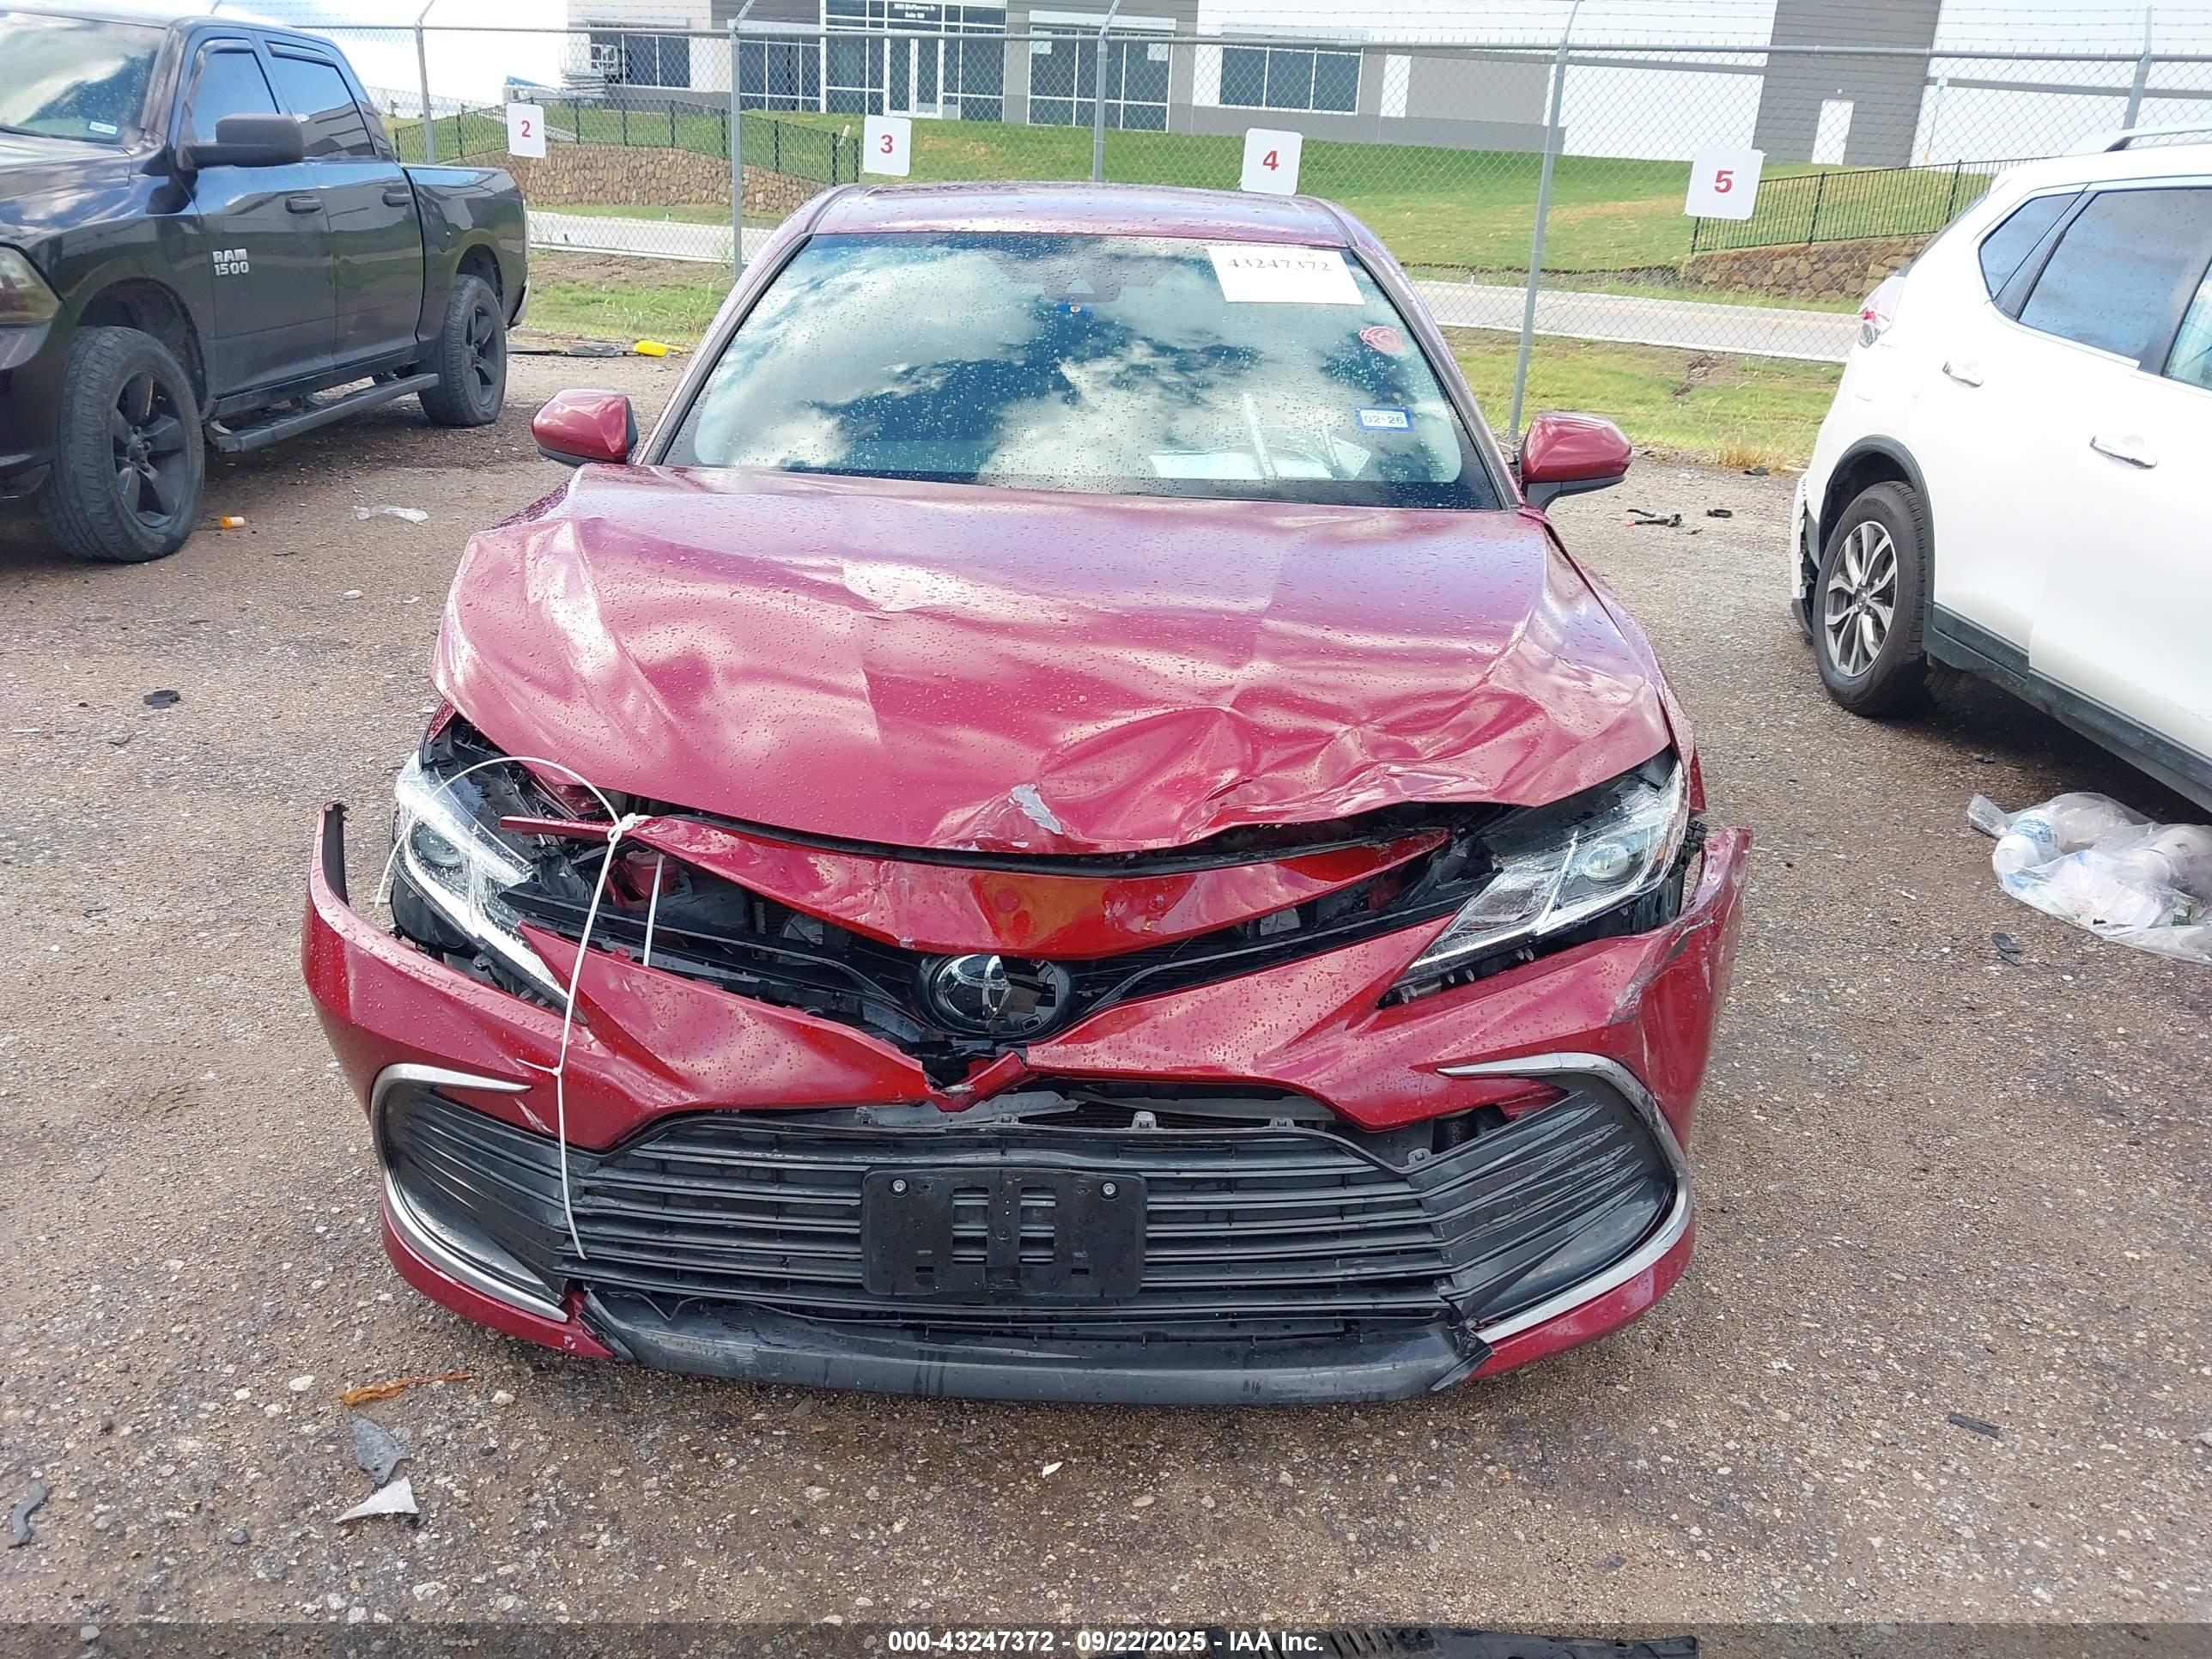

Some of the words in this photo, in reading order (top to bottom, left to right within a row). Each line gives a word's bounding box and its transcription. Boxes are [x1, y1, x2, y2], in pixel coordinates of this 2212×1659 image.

[521, 119, 532, 138] 2
[880, 134, 893, 154] 3
[1262, 149, 1279, 171] 4
[1714, 169, 1734, 193] 5
[212, 248, 248, 263] RAM
[1227, 258, 1333, 271] 43247372
[214, 261, 250, 276] 1500
